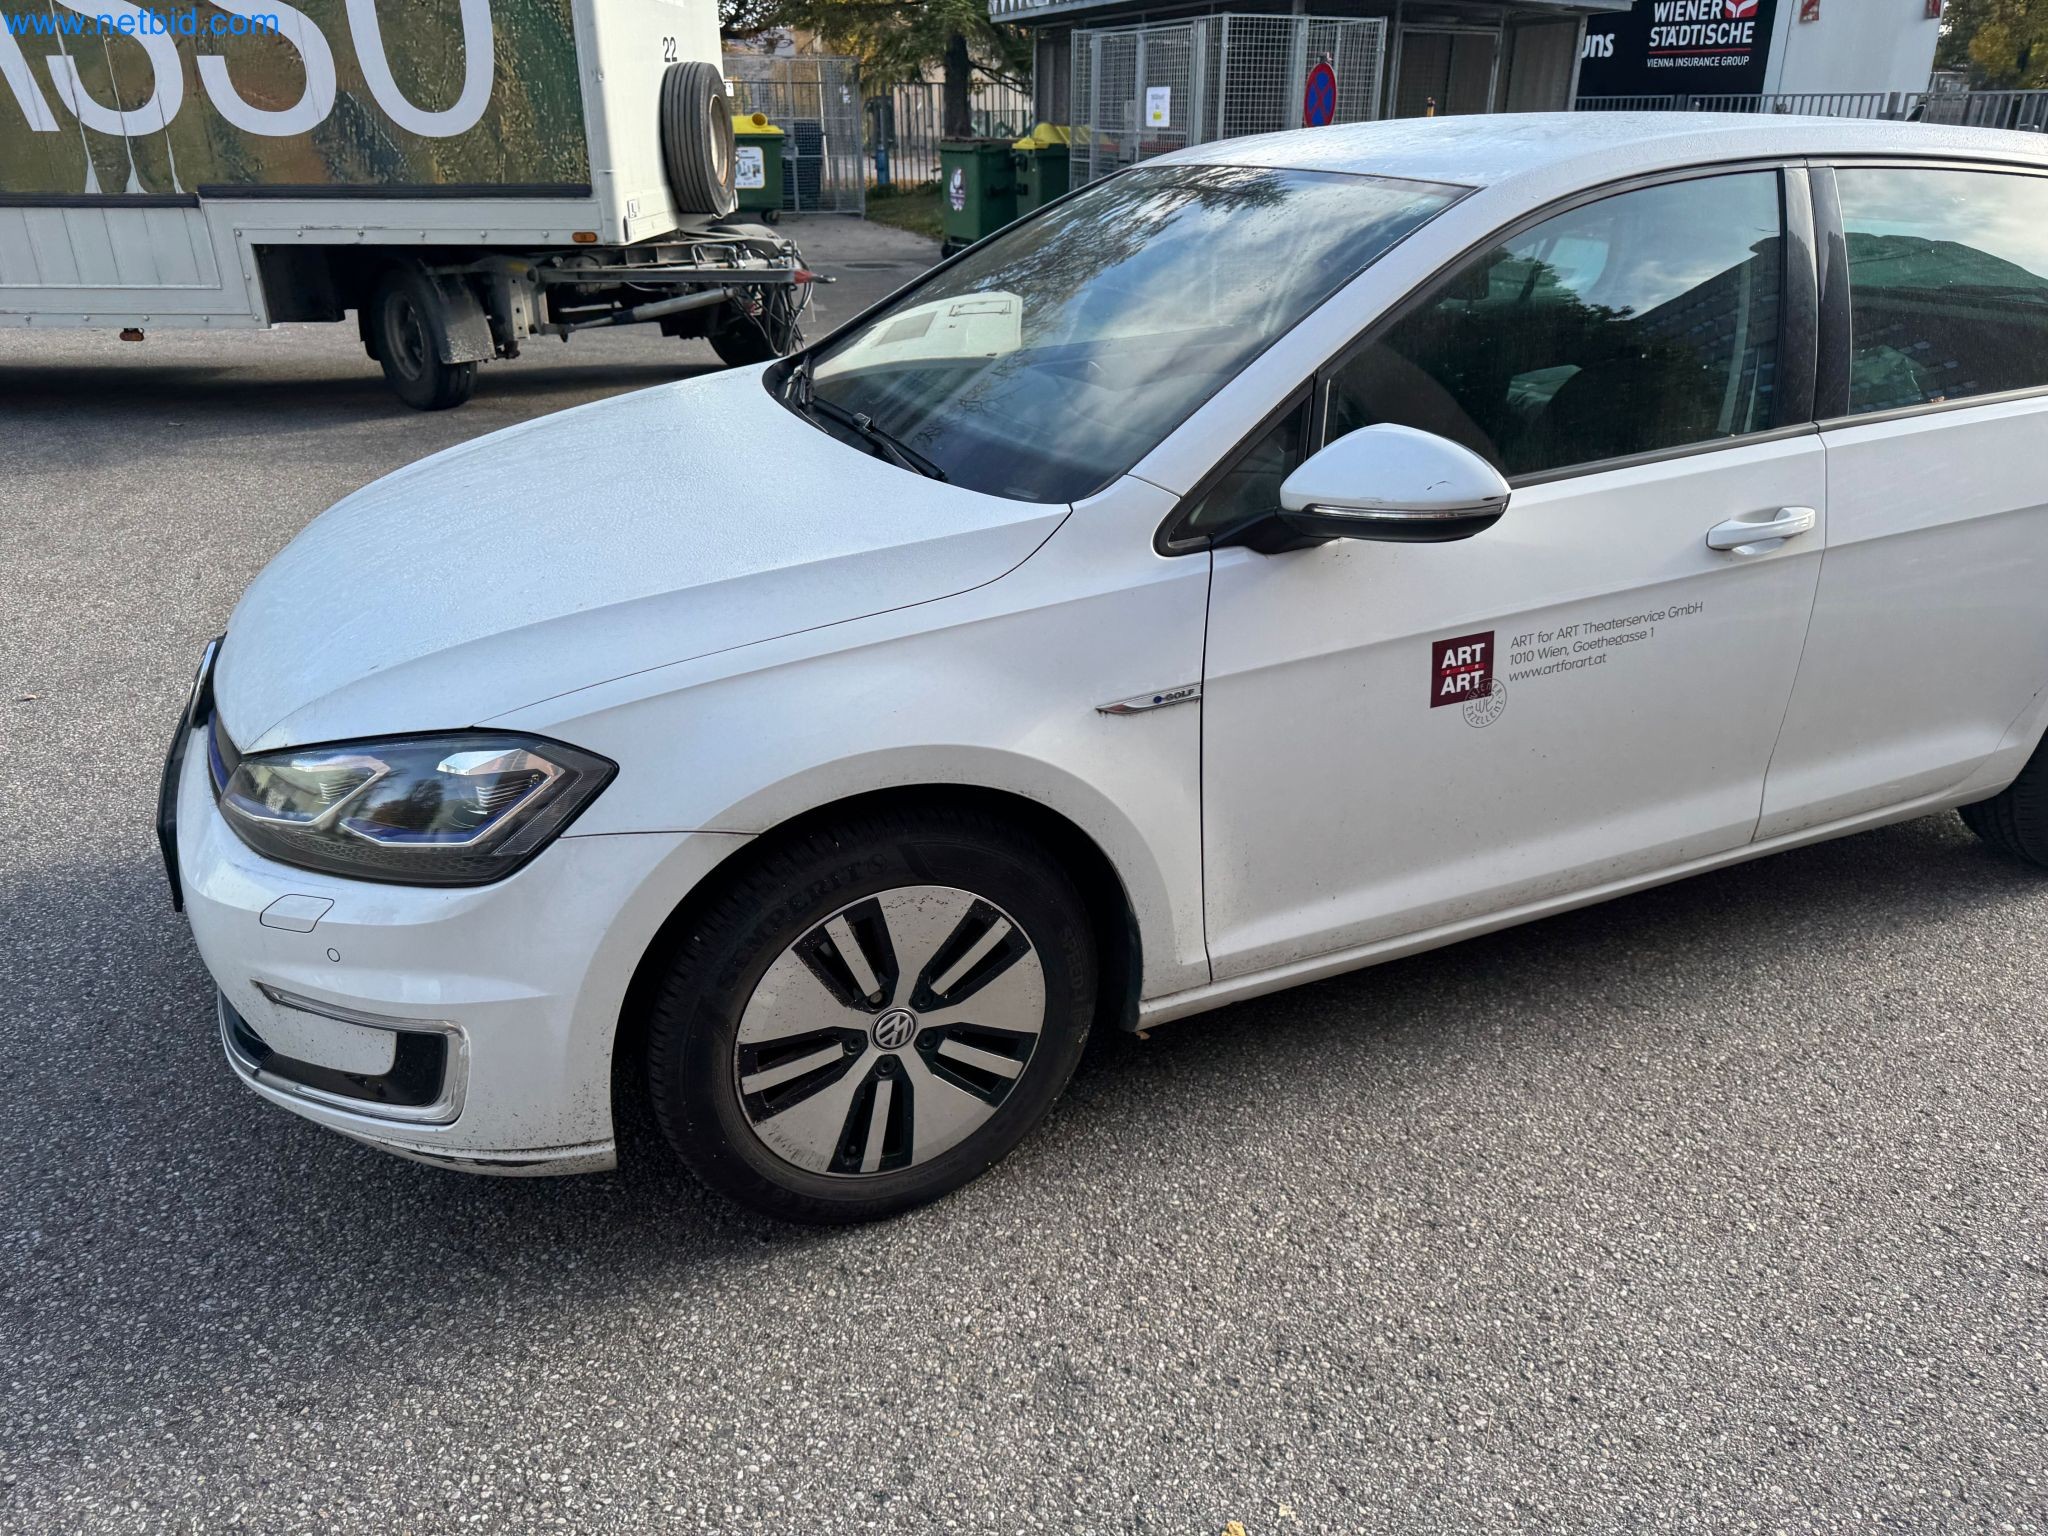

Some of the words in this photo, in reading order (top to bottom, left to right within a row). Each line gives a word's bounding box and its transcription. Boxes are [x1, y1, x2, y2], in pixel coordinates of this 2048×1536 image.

[1653, 0, 1721, 23] WIENER
[1648, 21, 1756, 47] STÄDTISCHE
[662, 36, 678, 63] 22
[1646, 58, 1674, 68] VIENNA
[1675, 56, 1720, 67] INSURANCE
[1721, 55, 1750, 66] GROUP
[1510, 633, 1535, 649] ART
[1537, 630, 1554, 644] for
[1556, 624, 1580, 640] ART
[1582, 610, 1666, 635] Theaterservice
[1667, 601, 1704, 618] GmbH
[1441, 642, 1486, 669] ART
[1510, 650, 1535, 666] 1010
[1537, 646, 1570, 660] Wien,
[1572, 630, 1648, 653] Goethegasse
[1650, 626, 1655, 638] 1
[1508, 652, 1608, 682] www.artforart.at
[1440, 669, 1485, 696] ART
